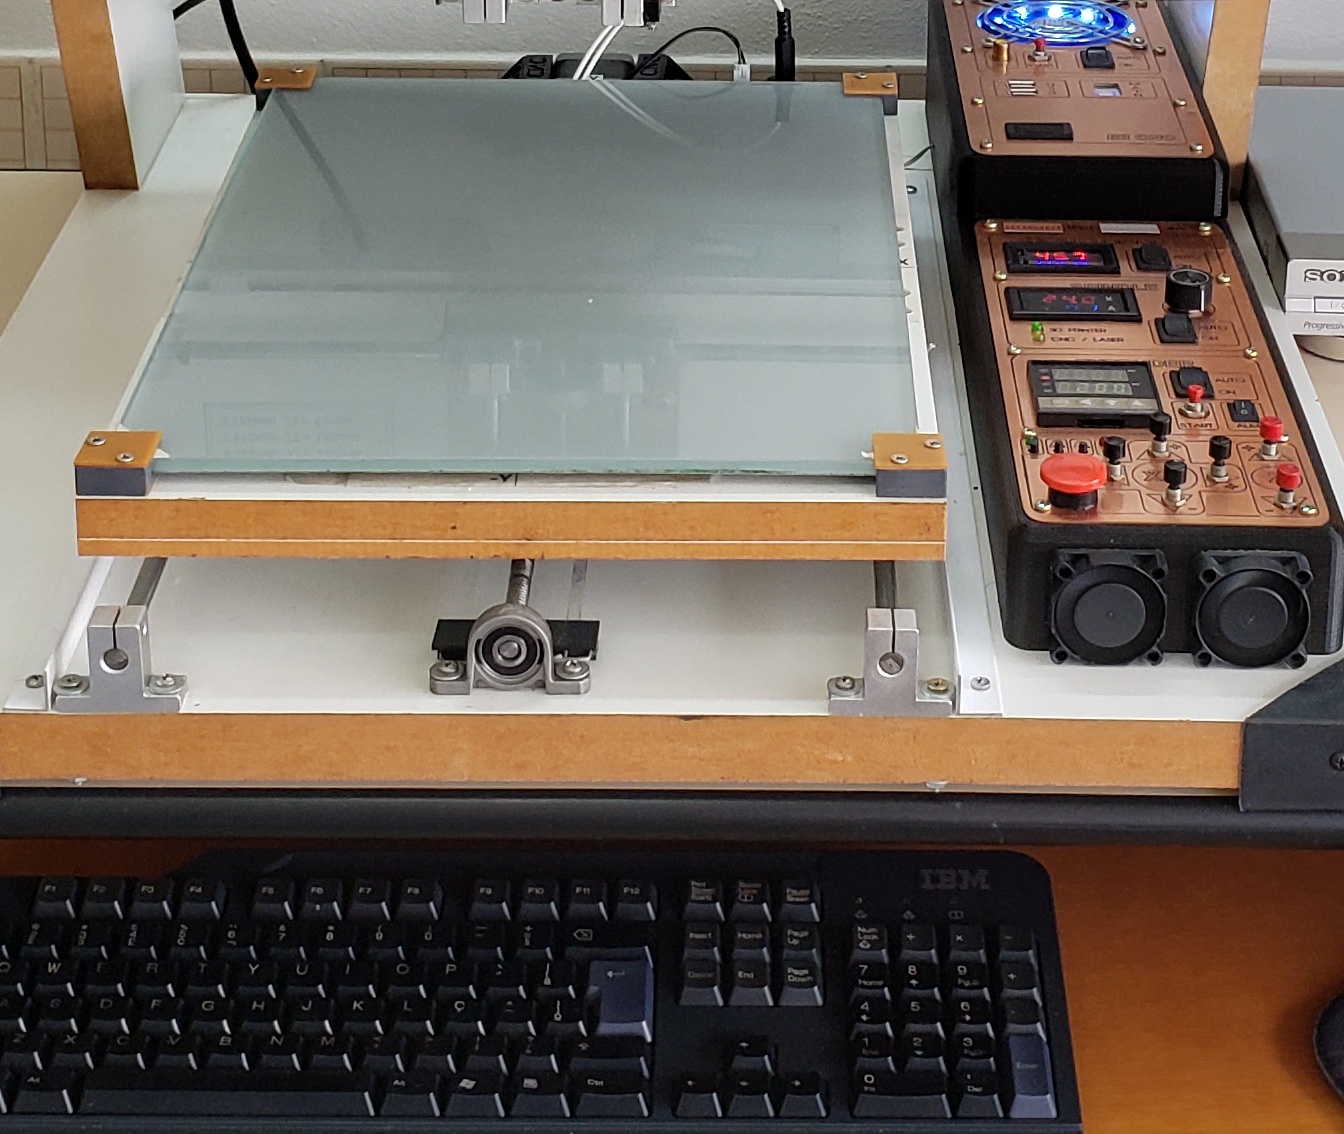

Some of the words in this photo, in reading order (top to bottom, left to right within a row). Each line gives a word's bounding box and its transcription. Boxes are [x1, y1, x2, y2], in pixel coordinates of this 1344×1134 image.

[920, 868, 991, 891] IBM
[528, 887, 544, 895] F10
[47, 962, 62, 974] W
[858, 965, 868, 976] 7
[907, 965, 917, 976] 8
[957, 965, 967, 976] 9
[860, 1001, 870, 1012] 4
[910, 1001, 920, 1012] 5
[960, 1001, 970, 1012] 6
